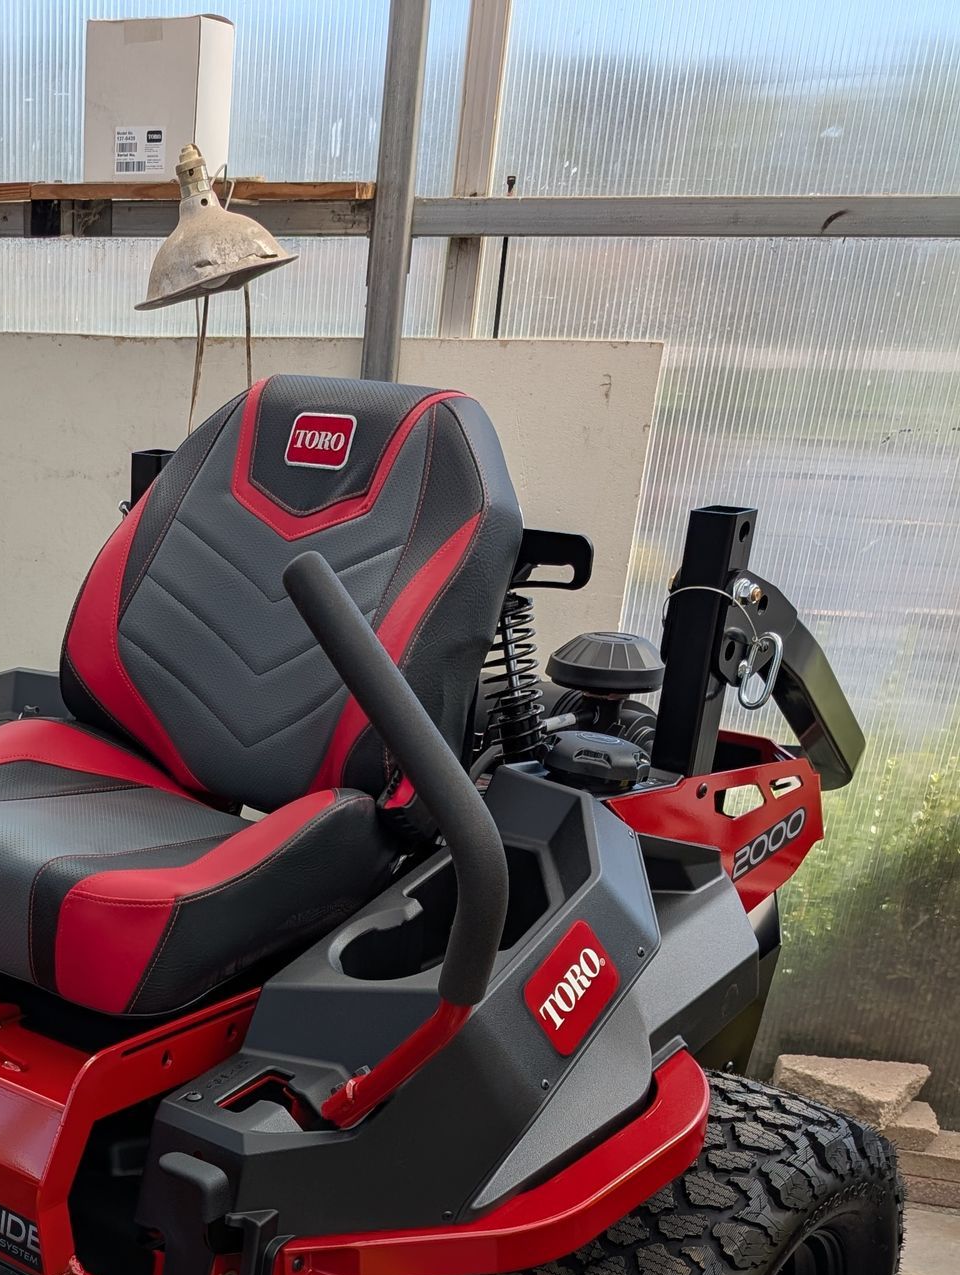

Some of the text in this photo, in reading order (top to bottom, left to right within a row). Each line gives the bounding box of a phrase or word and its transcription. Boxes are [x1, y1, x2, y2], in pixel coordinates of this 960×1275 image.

[293, 429, 346, 452] TORO
[732, 808, 806, 880] 2000
[539, 947, 601, 1031] TORO
[0, 1238, 39, 1265] SYSTEM
